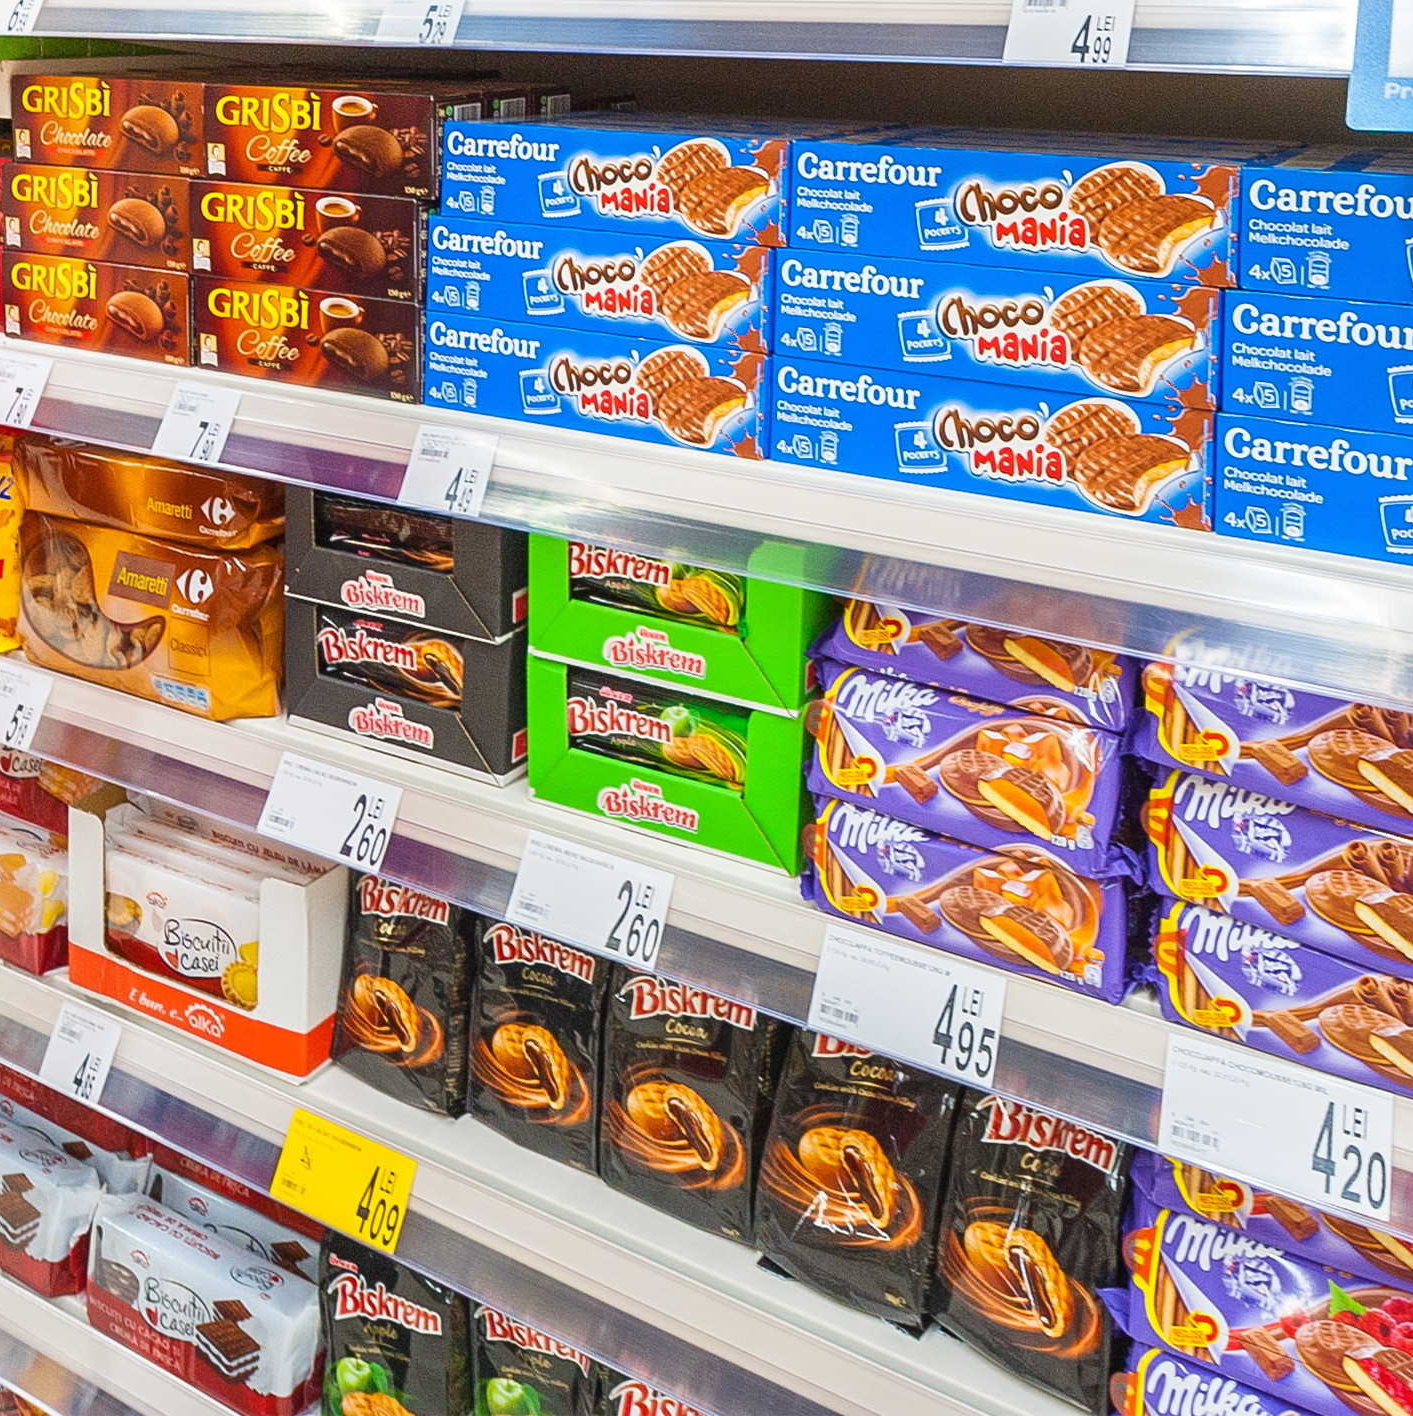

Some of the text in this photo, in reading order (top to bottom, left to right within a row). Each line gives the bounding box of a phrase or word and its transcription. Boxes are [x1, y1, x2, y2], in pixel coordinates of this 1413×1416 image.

[1070, 14, 1115, 64] 4 LEI
[1092, 36, 1112, 64] 99
[40, 124, 112, 152] Chocolate
[245, 137, 313, 166] Coffee
[447, 130, 560, 161] Carrefour
[1248, 218, 1333, 236] Chocolat lait
[1248, 232, 1350, 251] Melkchocolade
[147, 496, 193, 521] Amaretti
[445, 466, 478, 512] 4 LEI
[458, 487, 475, 513] 49
[323, 629, 417, 670] Biskrem
[831, 672, 940, 723] Milka
[566, 697, 672, 743] Biskrem
[339, 794, 384, 857] 2 LEI
[356, 826, 387, 867] 60
[665, 1017, 709, 1044] Cocoa
[932, 984, 984, 1065] 4 LEI
[955, 1021, 996, 1078] 95
[1312, 1102, 1368, 1194] 4 LEI
[355, 1165, 381, 1221] 4
[1341, 1145, 1386, 1209] 20
[368, 1204, 400, 1246] 09
[328, 1271, 443, 1337] Biskrem
